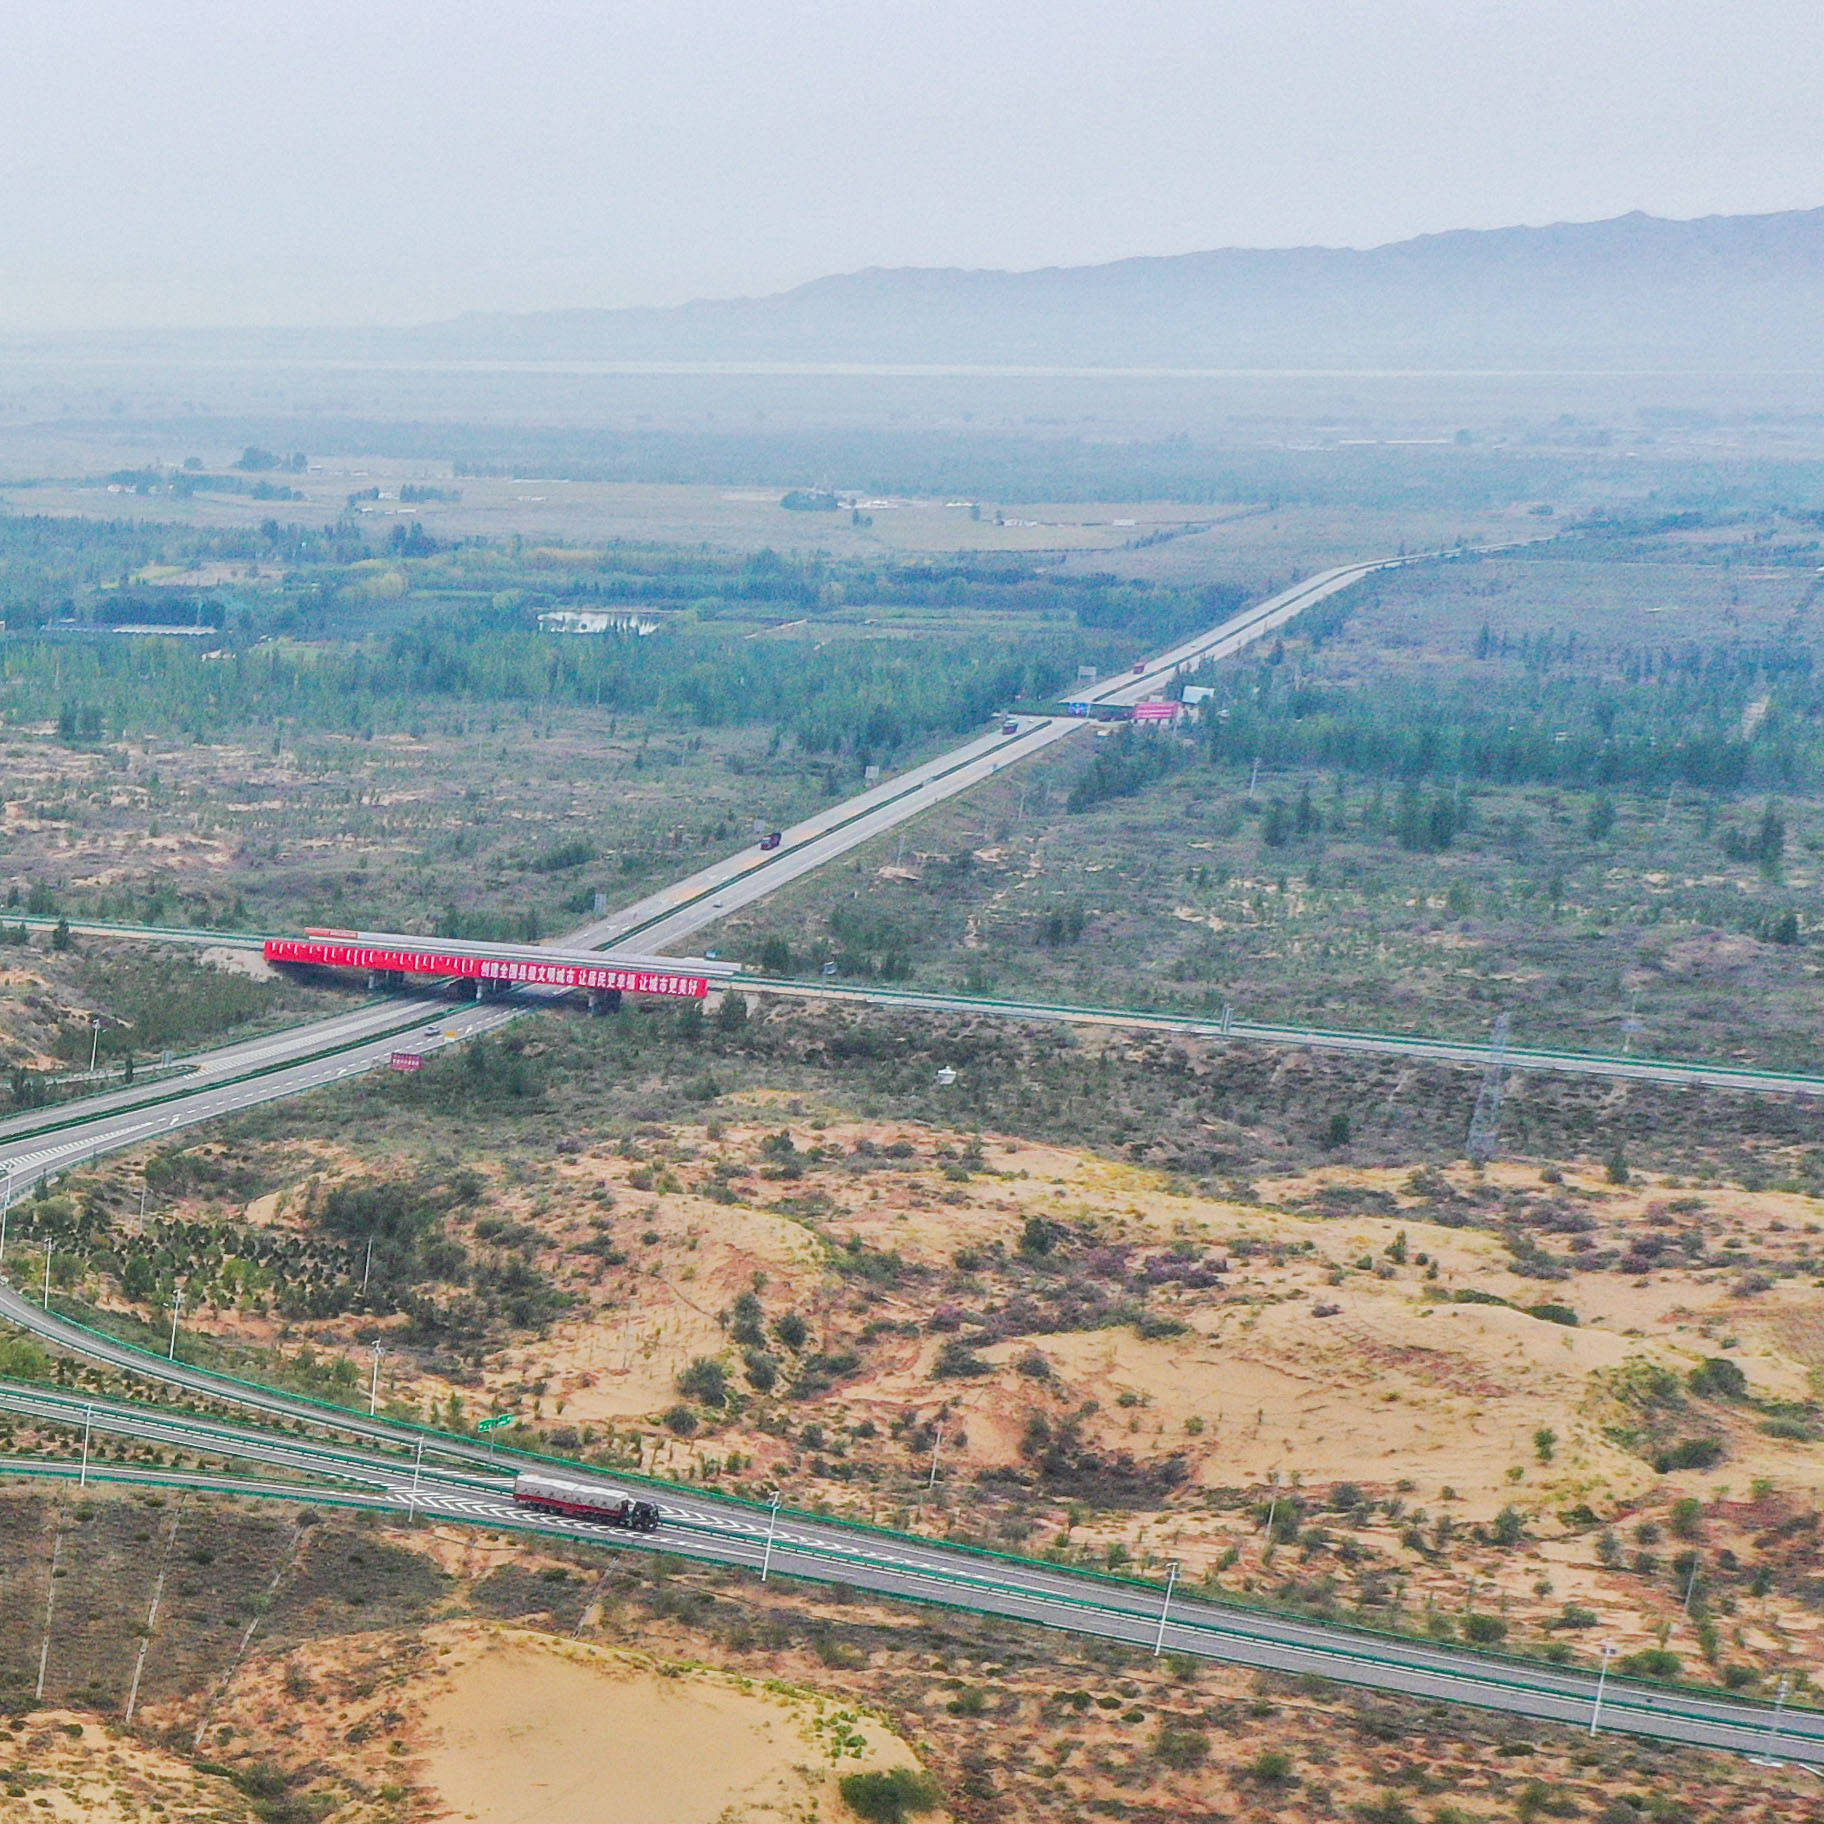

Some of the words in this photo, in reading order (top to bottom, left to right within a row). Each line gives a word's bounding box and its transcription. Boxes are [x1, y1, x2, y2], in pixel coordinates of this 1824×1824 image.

[639, 975, 698, 996] 让城市更美好
